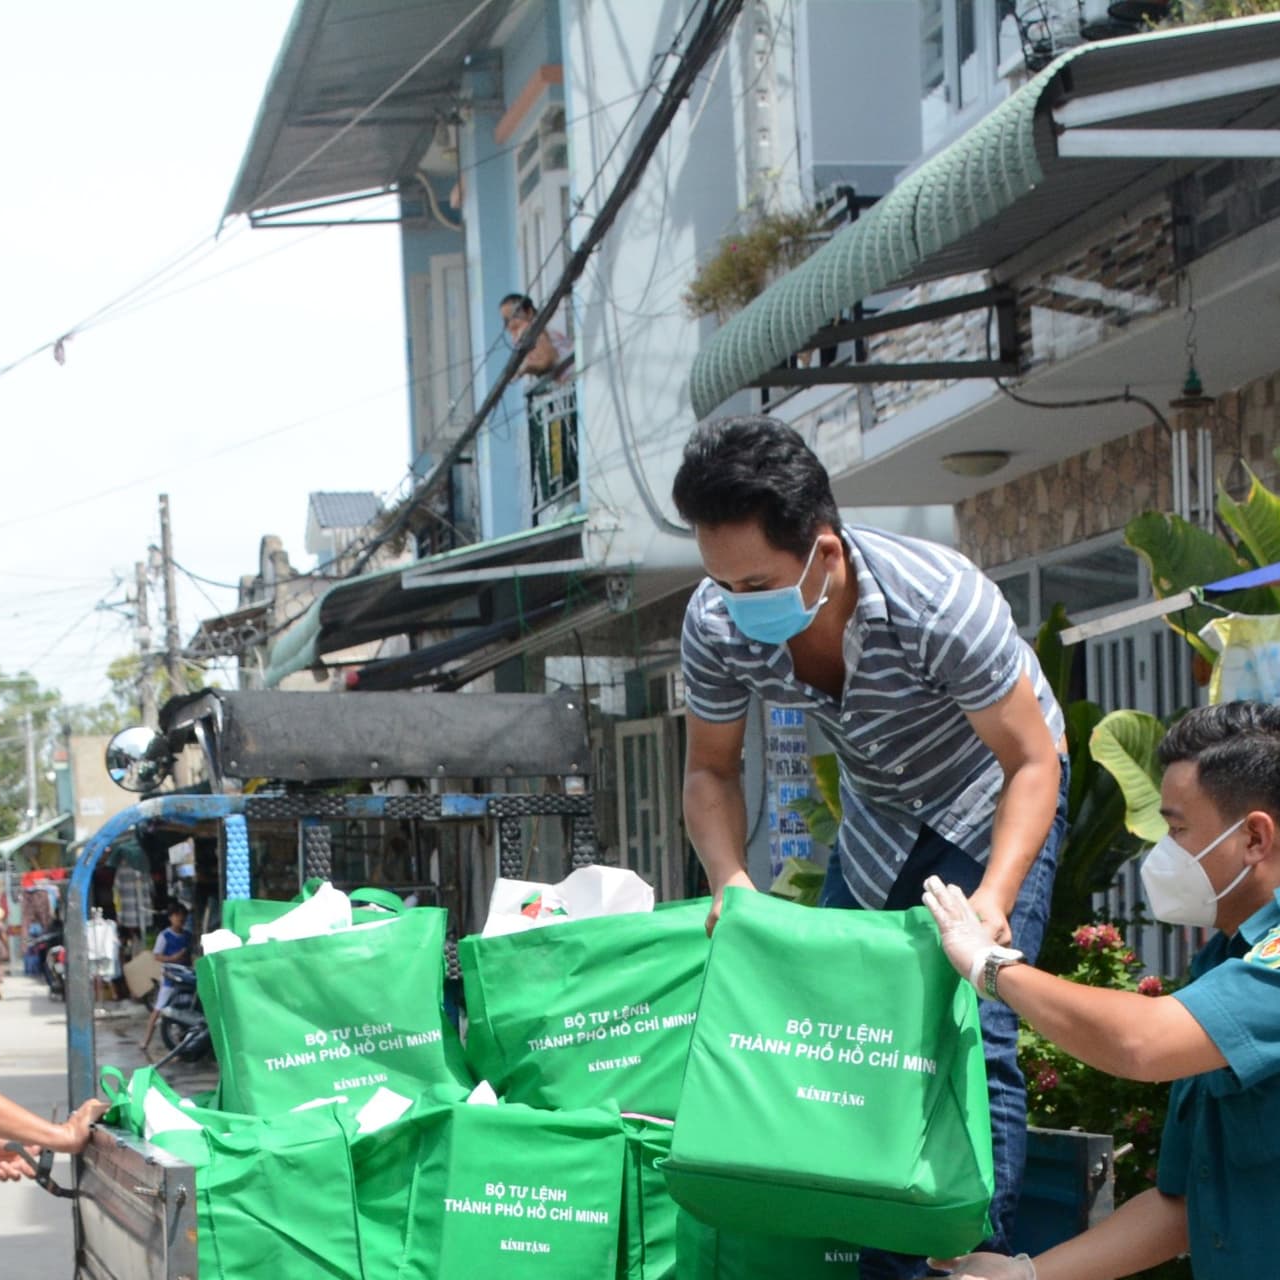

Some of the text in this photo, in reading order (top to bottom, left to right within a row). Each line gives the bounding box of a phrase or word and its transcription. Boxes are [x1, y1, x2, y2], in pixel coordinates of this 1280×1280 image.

[563, 1002, 650, 1029] BỘ TƯ LỆNH
[304, 1023, 393, 1047] BỘ TƯ LỆNH
[528, 1034, 573, 1052] THÀNH
[576, 1026, 607, 1043] PHỐ
[610, 1022, 631, 1038] HỒ
[634, 1016, 660, 1034] CHÍ
[786, 1018, 893, 1045] BỘ TƯ LỆNH
[265, 1029, 442, 1072] THÀNH PHỐ HỒ CHÍ MINH
[728, 1033, 791, 1056] THÀNH
[795, 1041, 834, 1062] PHỐ
[838, 1045, 864, 1065] HỒ
[868, 1050, 899, 1068] CHÍ
[485, 1181, 567, 1204] BỘ TƯ LỆNH
[444, 1197, 609, 1224] THÀNH PHỐ HỒ CHÍ MINH
